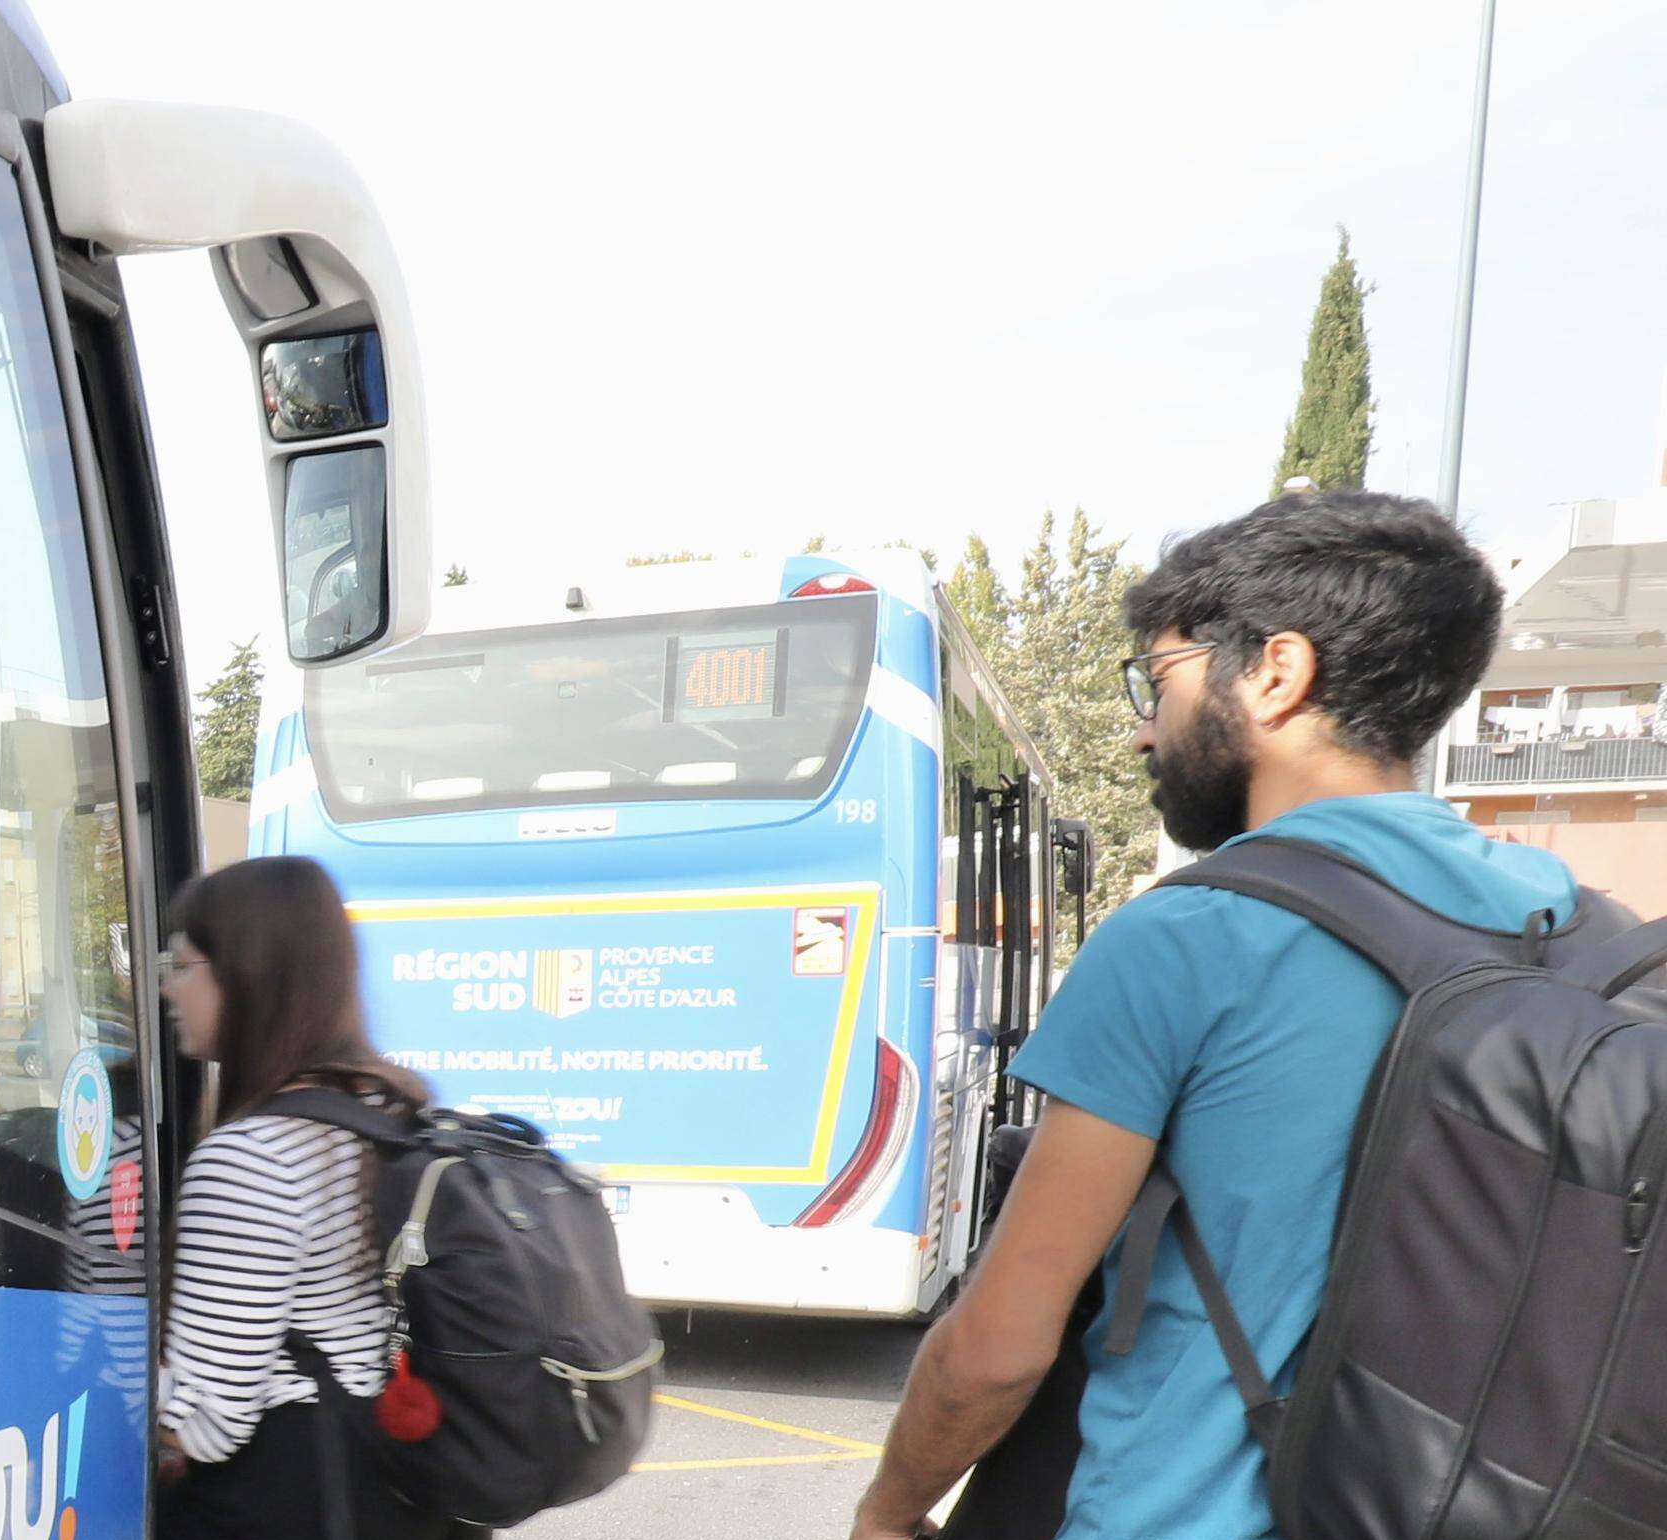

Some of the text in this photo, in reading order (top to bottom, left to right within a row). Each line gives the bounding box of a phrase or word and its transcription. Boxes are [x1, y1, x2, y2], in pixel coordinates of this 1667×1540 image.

[685, 648, 764, 707] 4001
[835, 799, 876, 823] 198
[392, 949, 527, 981] RÉGION
[599, 946, 714, 966] PROVENCE
[599, 967, 662, 987] ALPES
[452, 983, 526, 1011] SUD
[598, 986, 737, 1008] CÔTE D'AZUR
[378, 1045, 769, 1073] OTRE MOBILITÉ, NOTRE PRIORITÉ.
[556, 1096, 624, 1121] ZOU!
